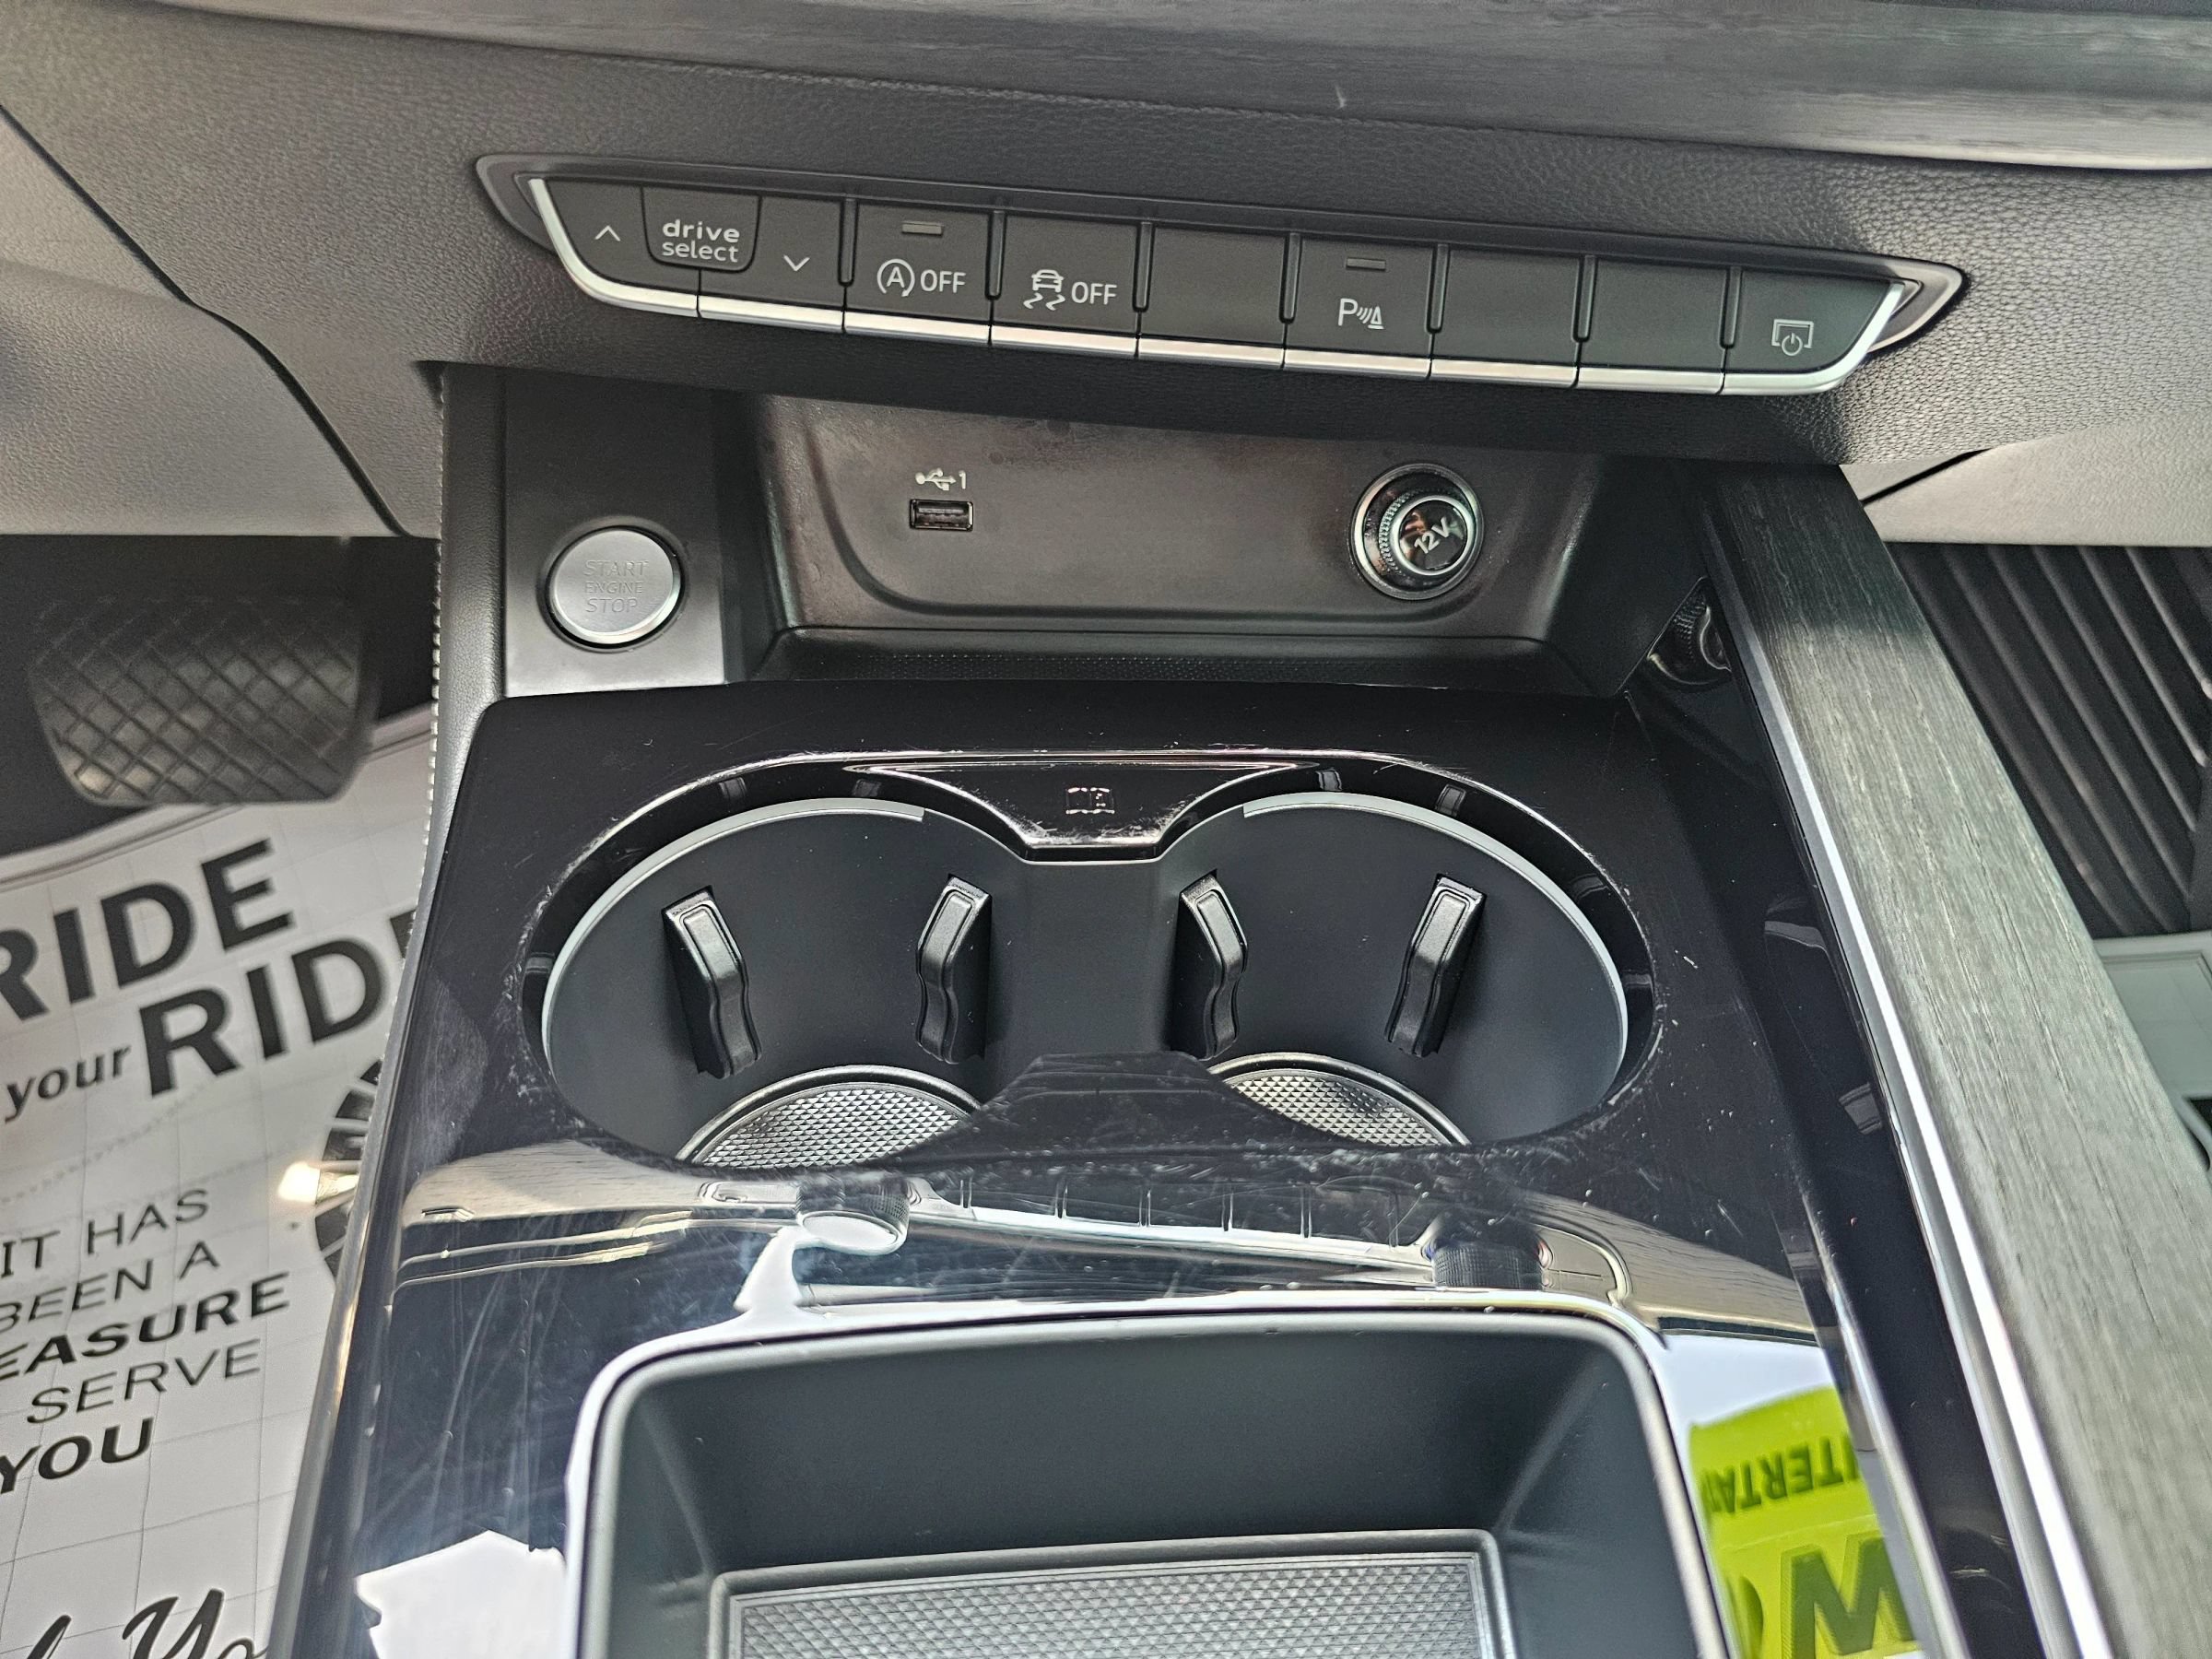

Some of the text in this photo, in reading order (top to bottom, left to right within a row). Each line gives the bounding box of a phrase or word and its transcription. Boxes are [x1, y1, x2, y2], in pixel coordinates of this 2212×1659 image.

[663, 218, 740, 243] drive
[662, 240, 739, 263] select
[920, 269, 966, 294] OFF
[1071, 281, 1117, 305] OFF
[959, 469, 966, 489] 1
[1414, 516, 1450, 554] 12V
[583, 560, 649, 577] START
[584, 582, 643, 594] ENGINE
[585, 598, 638, 614] STOP
[0, 838, 296, 1022] RIDE
[4, 1044, 131, 1123] your
[0, 1188, 209, 1278] IT HAS
[0, 1241, 220, 1334] BEEN A
[26, 1338, 262, 1424] SERVE
[0, 1418, 155, 1494] YOU
